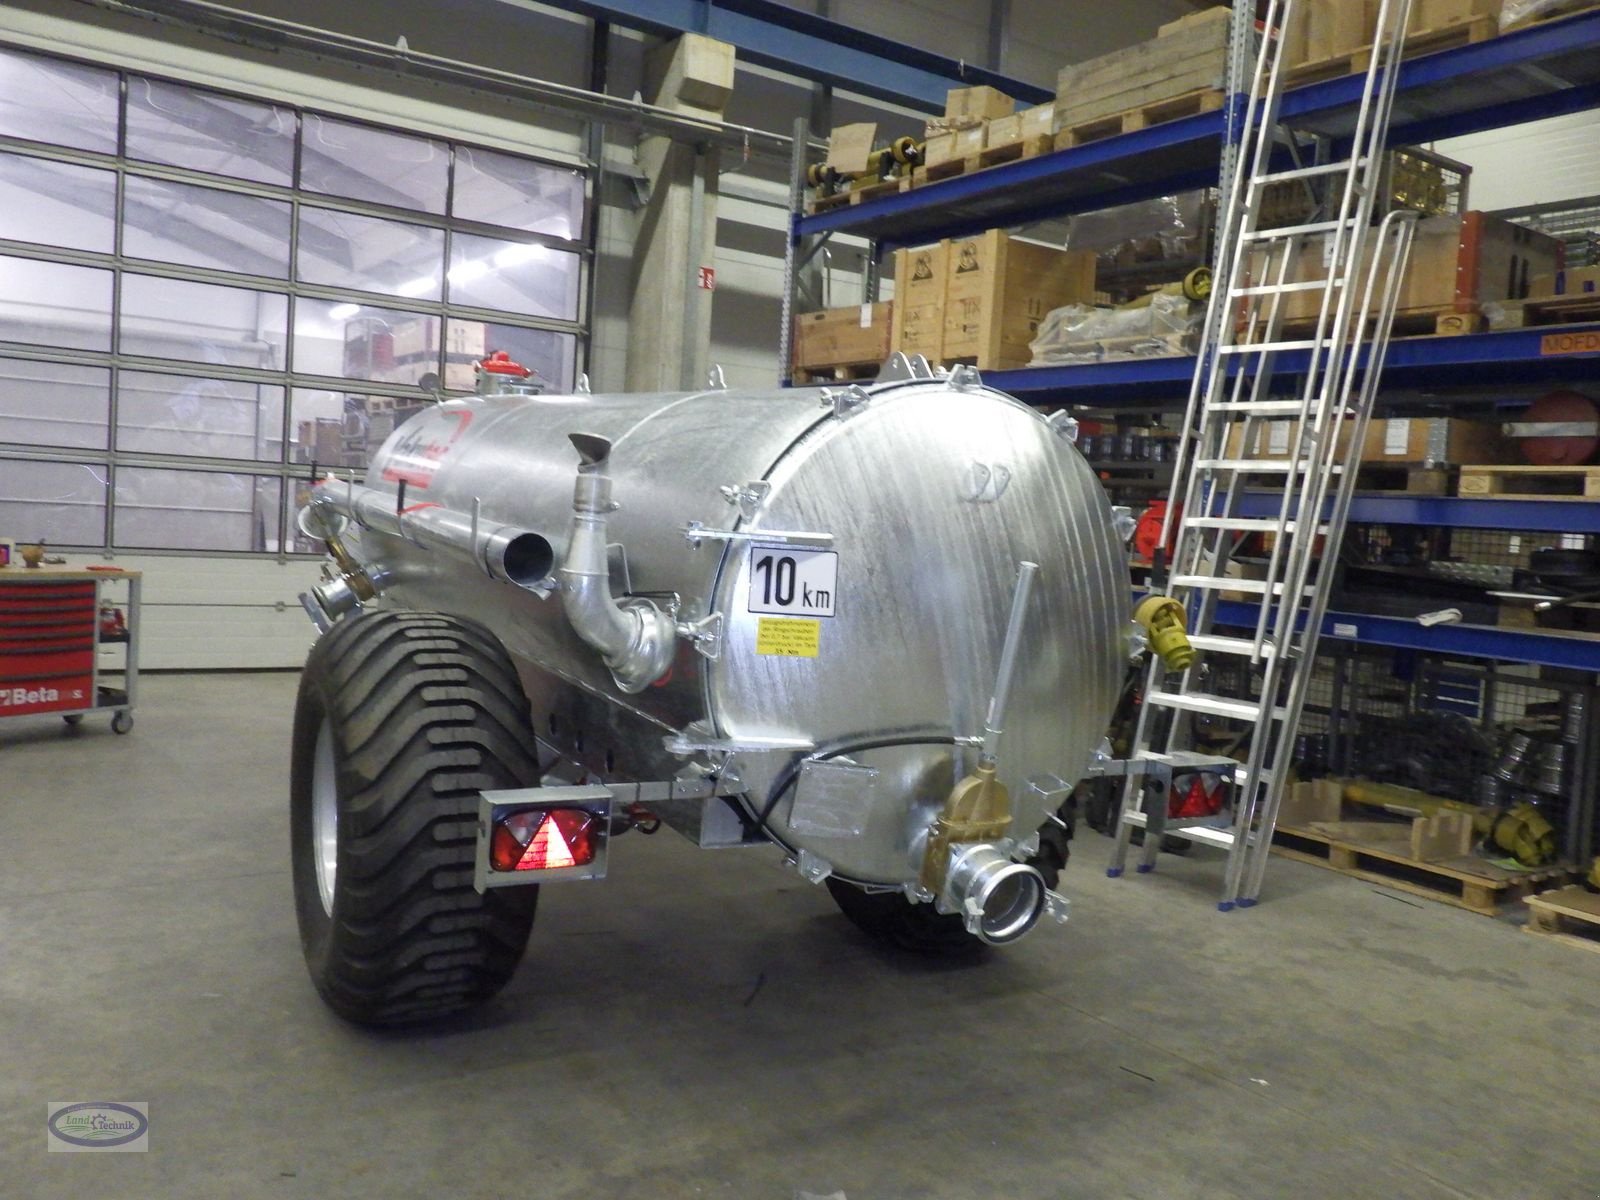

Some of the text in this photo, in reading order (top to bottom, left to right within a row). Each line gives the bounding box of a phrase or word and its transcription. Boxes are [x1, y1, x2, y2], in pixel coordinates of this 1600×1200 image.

[756, 556, 830, 608] 10 km
[13, 687, 59, 704] Beta
